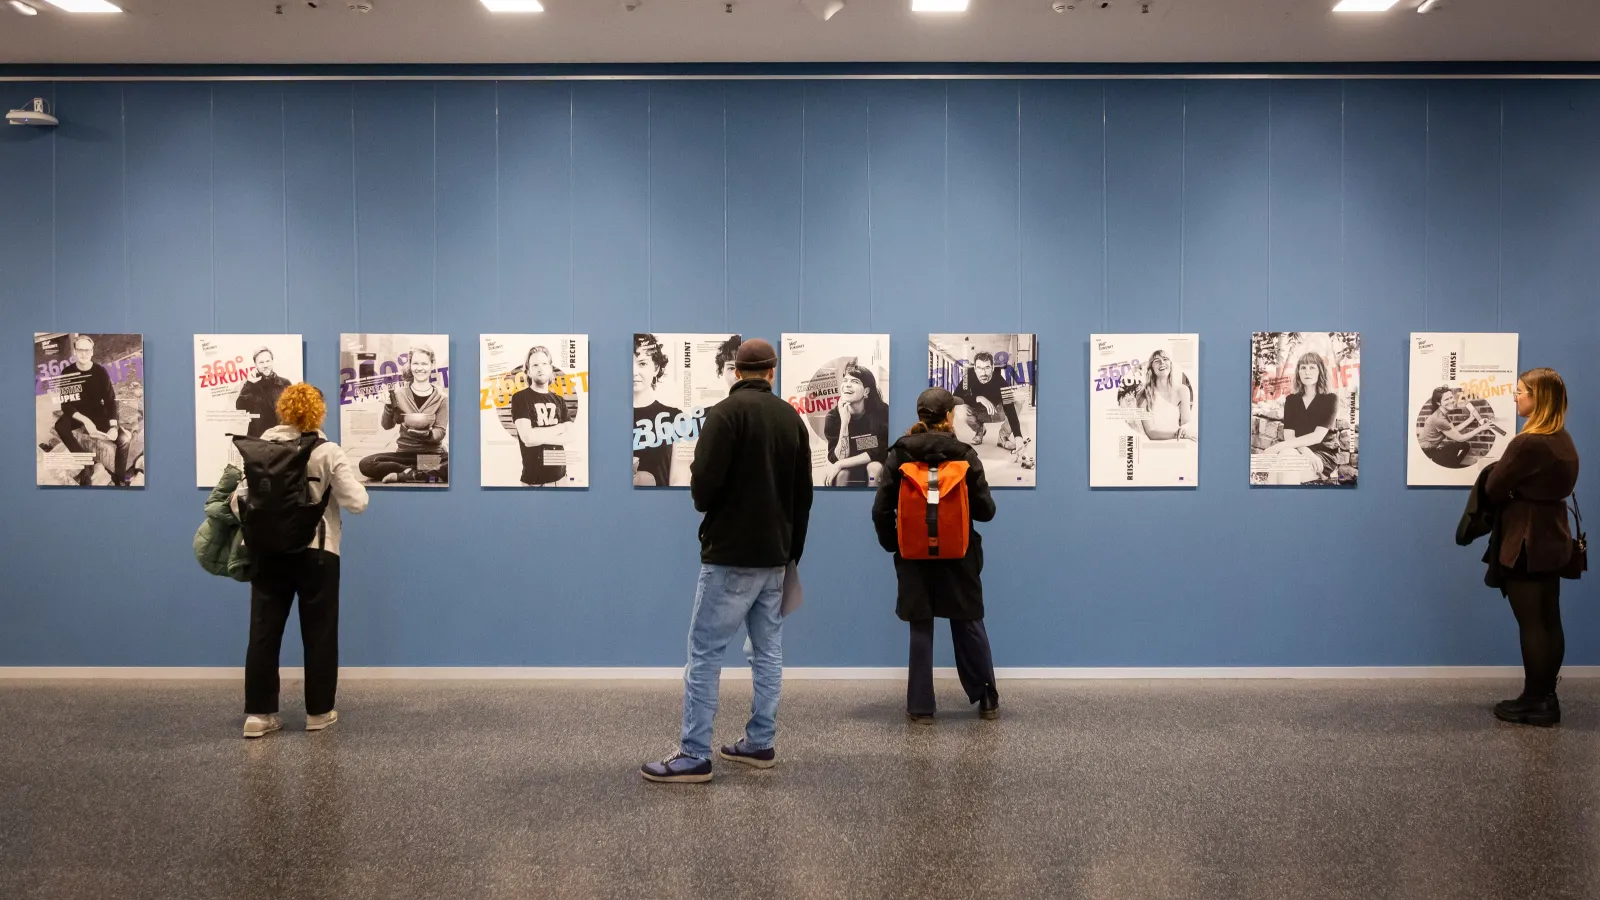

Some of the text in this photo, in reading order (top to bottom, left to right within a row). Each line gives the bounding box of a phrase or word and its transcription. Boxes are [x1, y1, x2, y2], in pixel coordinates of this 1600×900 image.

[199, 366, 256, 388] ZUKUN
[202, 356, 243, 382] 360°
[812, 387, 839, 397] NÄGELE
